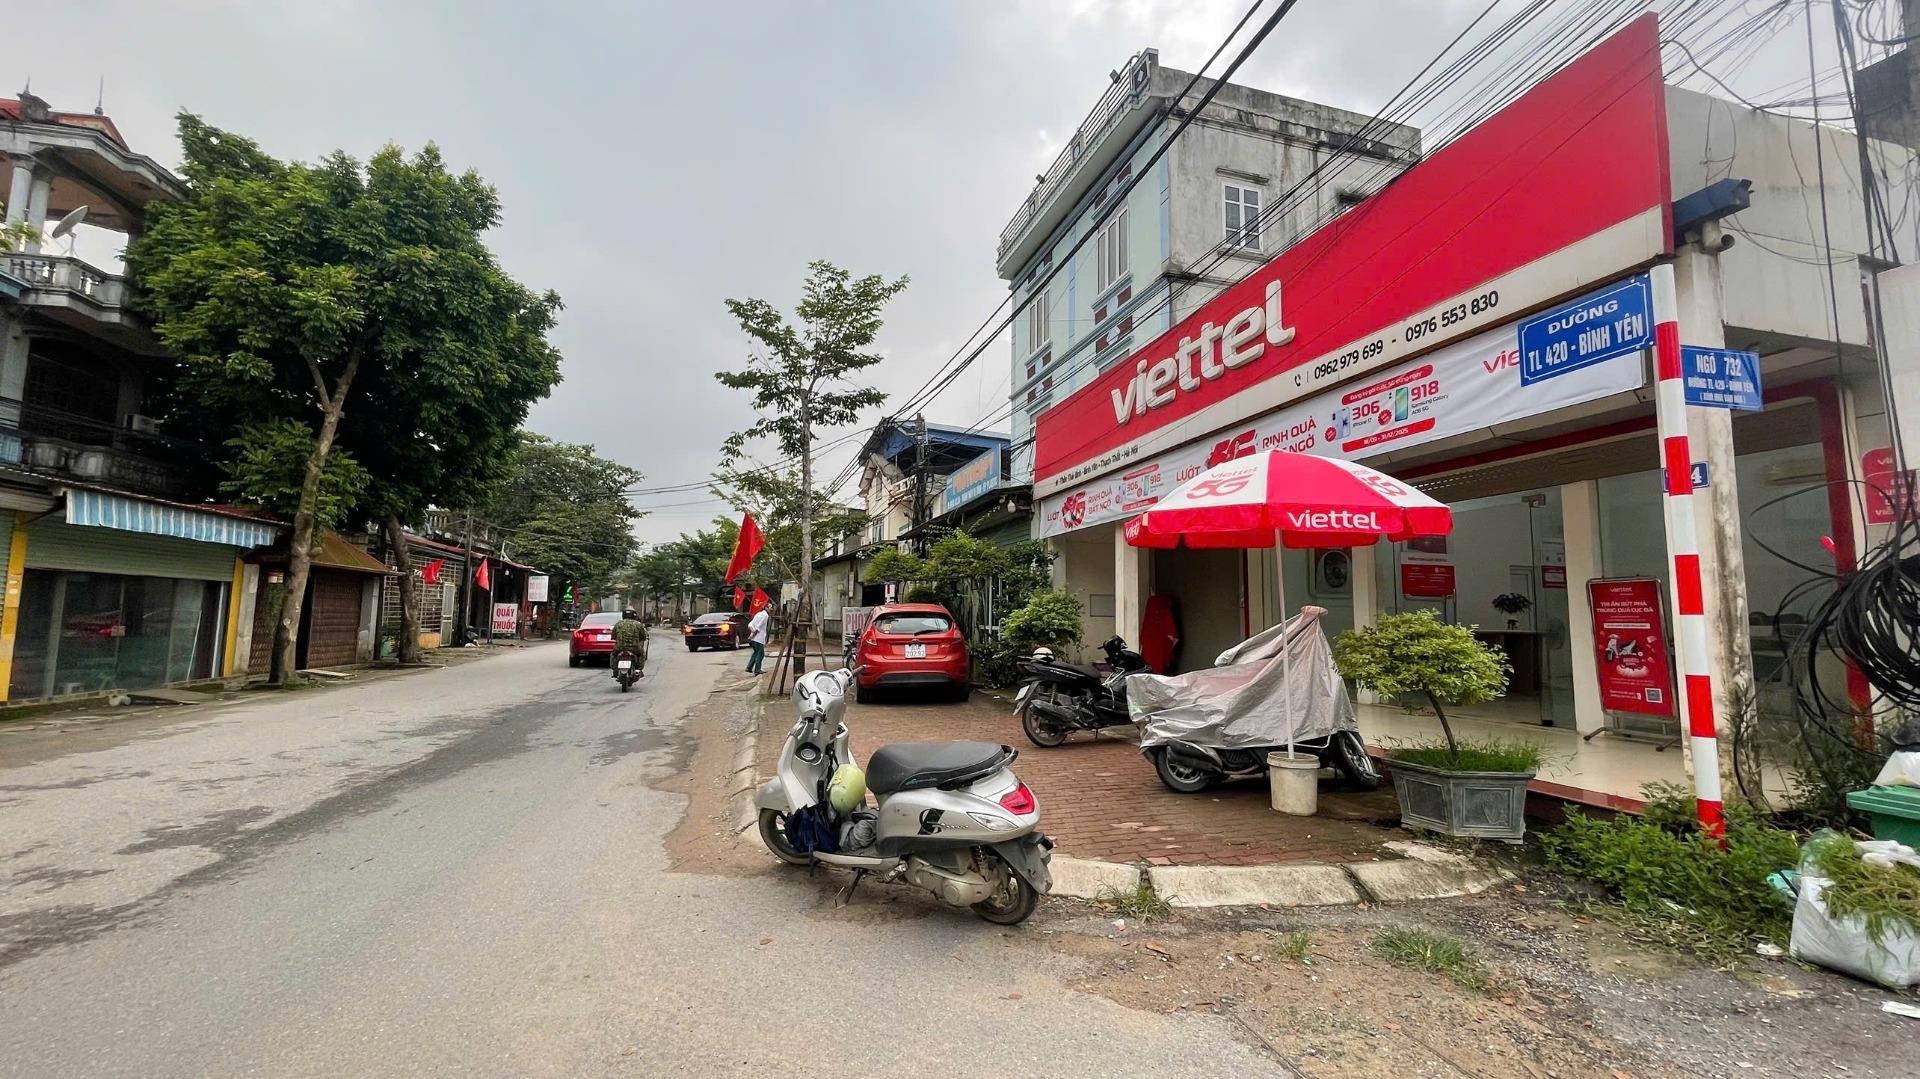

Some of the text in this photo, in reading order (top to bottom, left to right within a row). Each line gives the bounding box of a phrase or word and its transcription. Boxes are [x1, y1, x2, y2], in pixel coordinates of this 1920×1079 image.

[1548, 300, 1618, 334] ĐƯỜNG
[1314, 359, 1338, 380] 0962
[1339, 350, 1359, 369] 979
[1362, 339, 1384, 359] 699
[1405, 317, 1437, 342] 0976
[1441, 303, 1467, 327] 553
[1471, 290, 1499, 315] 830
[1528, 350, 1542, 372] TL
[1546, 340, 1568, 366] 420
[1578, 326, 1610, 356] BÌNH
[1614, 313, 1643, 343] YÊN
[1111, 280, 1296, 425] viettel
[1696, 353, 1742, 377] NGÕ 732
[1411, 380, 1439, 401] 918
[1352, 400, 1380, 420] 306
[1262, 429, 1288, 449] RINH
[1291, 415, 1317, 438] QUÀ
[1289, 434, 1315, 453] NGỜ
[1176, 464, 1201, 482] LƯỚT
[1186, 473, 1254, 500] 5G
[1287, 509, 1382, 530] viettel
